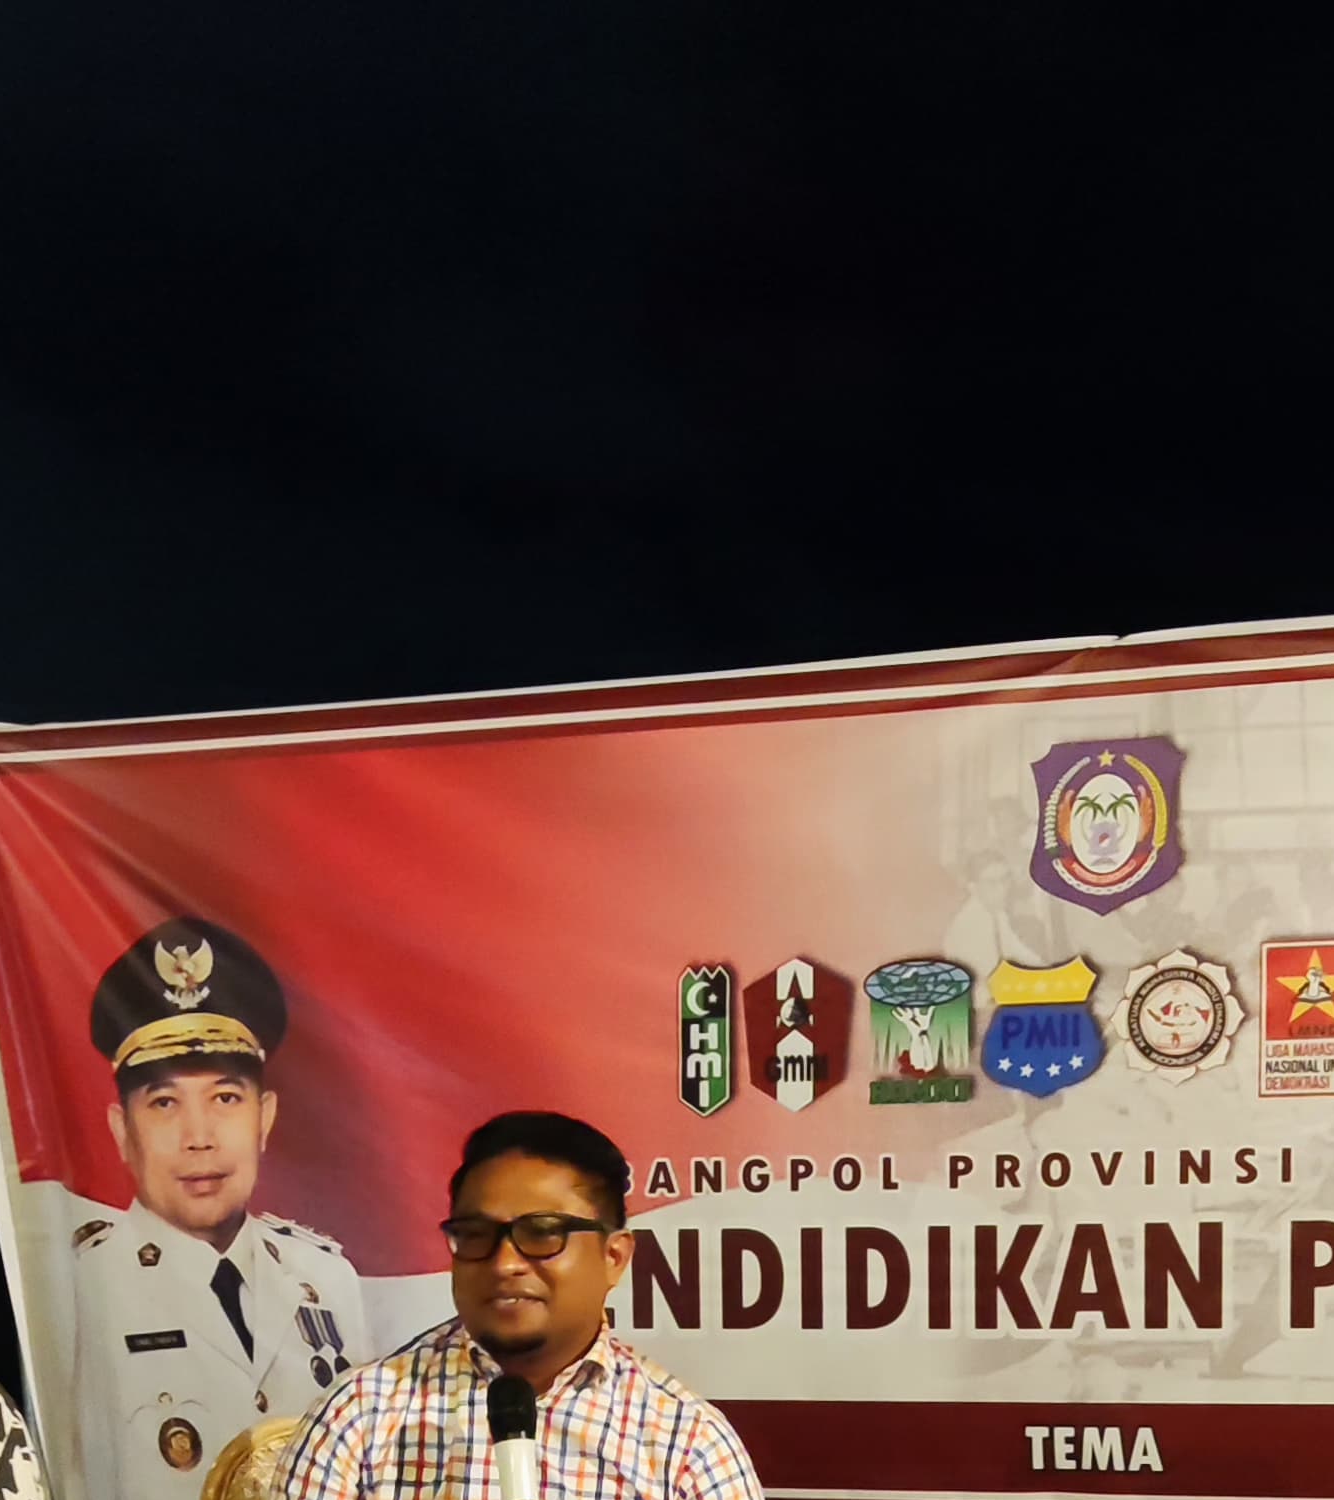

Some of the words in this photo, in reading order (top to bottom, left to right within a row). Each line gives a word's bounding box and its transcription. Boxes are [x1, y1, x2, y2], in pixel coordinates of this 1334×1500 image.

[1001, 1012, 1081, 1050] PMII
[1265, 1060, 1320, 1074] NASIONAL
[948, 1147, 1293, 1189] PROVINSI
[603, 1221, 1224, 1331] NDIDIKAN
[1024, 1426, 1164, 1472] TEMA
